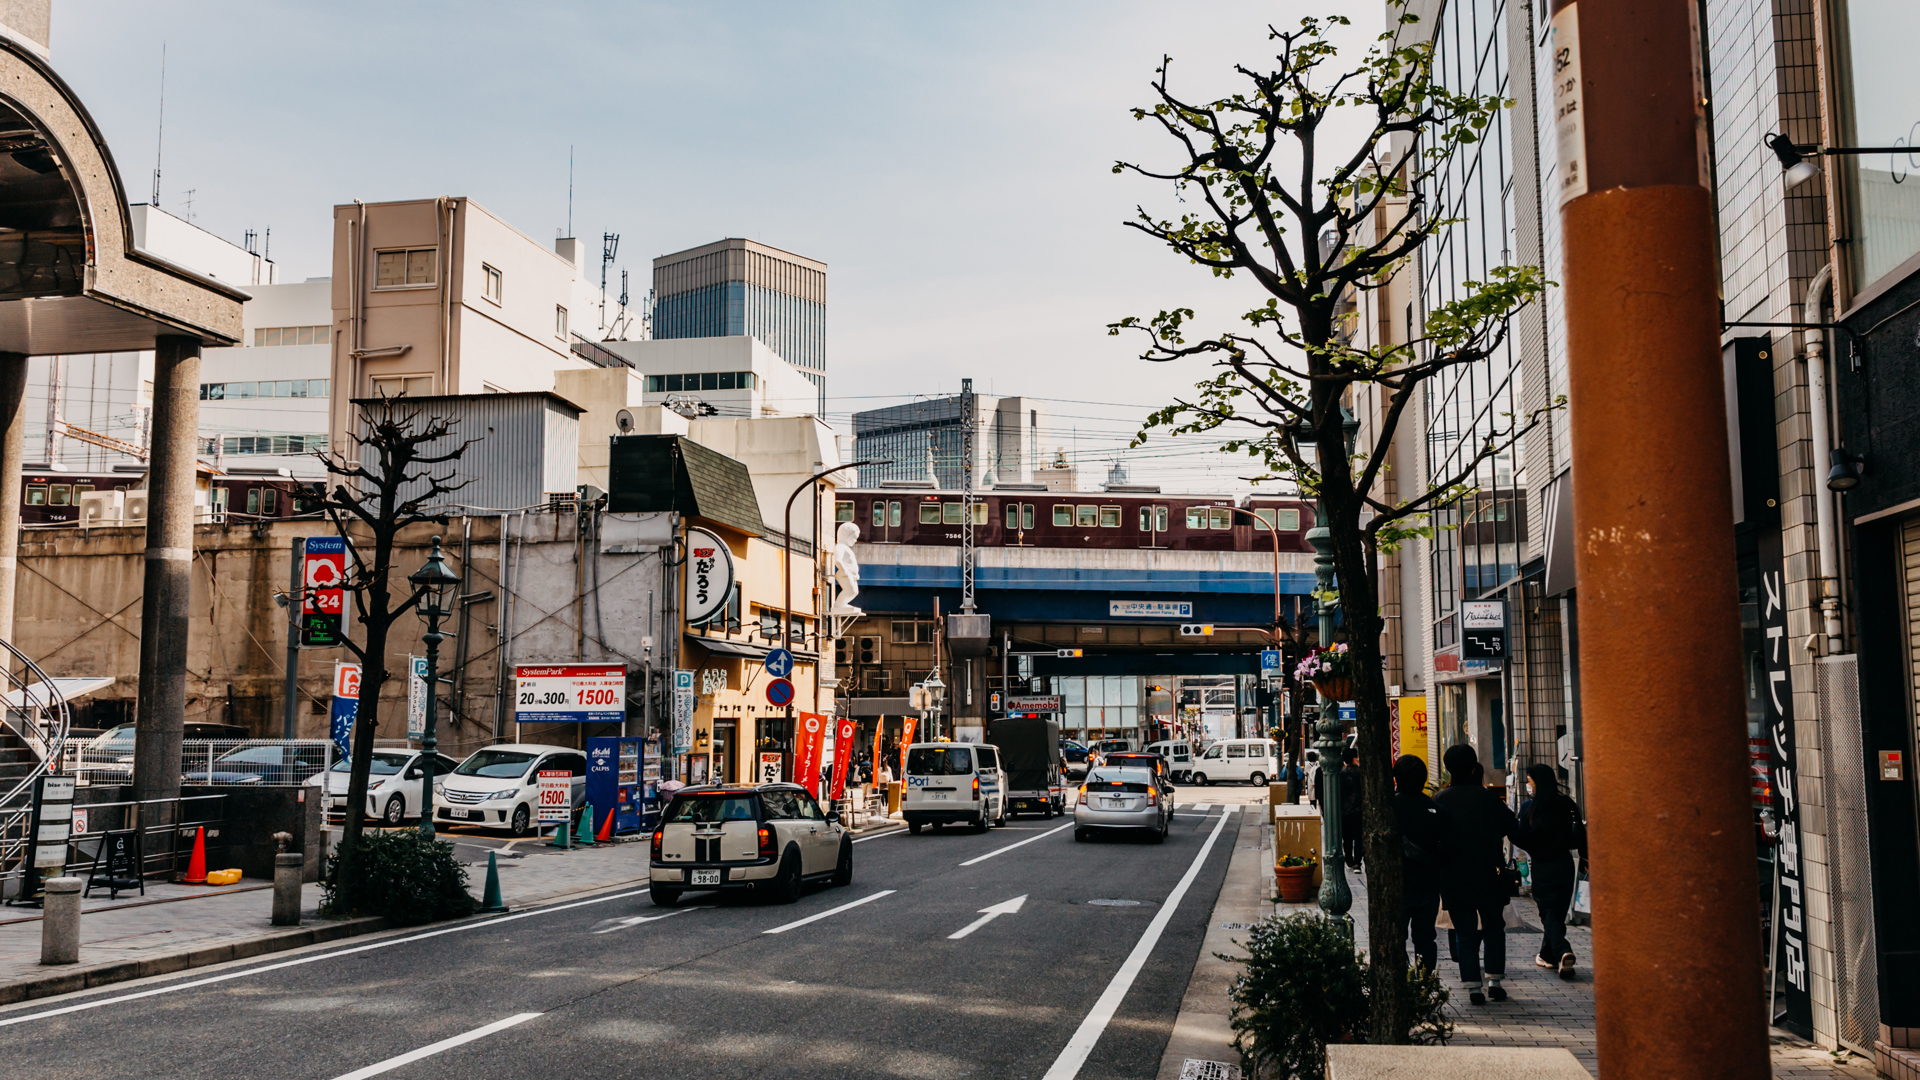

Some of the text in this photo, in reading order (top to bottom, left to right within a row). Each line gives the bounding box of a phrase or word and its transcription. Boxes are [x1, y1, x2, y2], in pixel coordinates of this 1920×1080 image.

[308, 540, 342, 551] System
[695, 558, 710, 605] たろう
[521, 668, 563, 676] SystemPark
[680, 675, 689, 686] P
[1763, 571, 1807, 992] ストレッチ専門店
[540, 790, 570, 804] 1500円
[697, 875, 719, 884] 98-00
